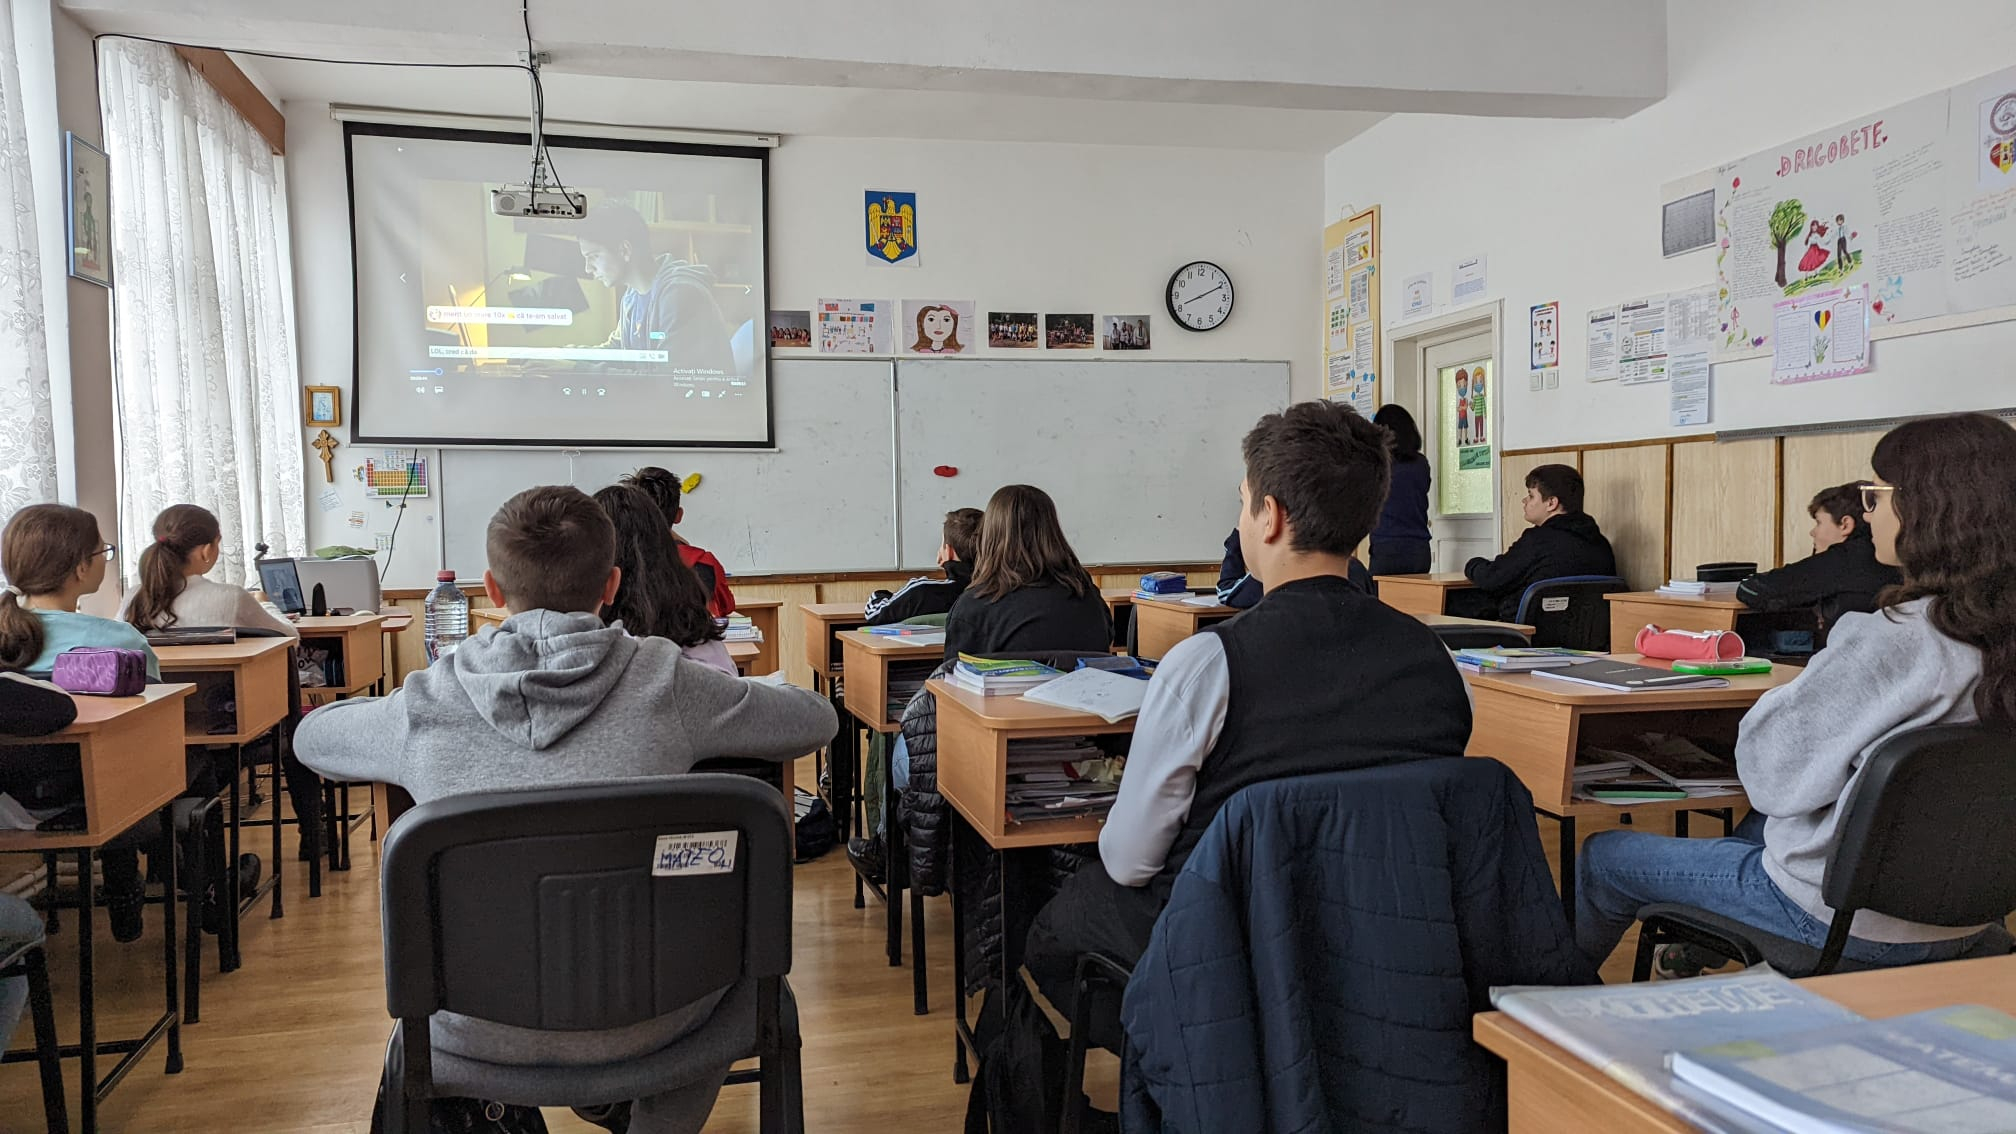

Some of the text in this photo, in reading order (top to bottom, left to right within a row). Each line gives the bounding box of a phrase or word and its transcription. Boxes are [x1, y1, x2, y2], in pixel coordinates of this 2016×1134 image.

[1781, 120, 1883, 177] DRAGOBETE
[1188, 272, 1192, 280] 11
[1198, 268, 1205, 276] 12
